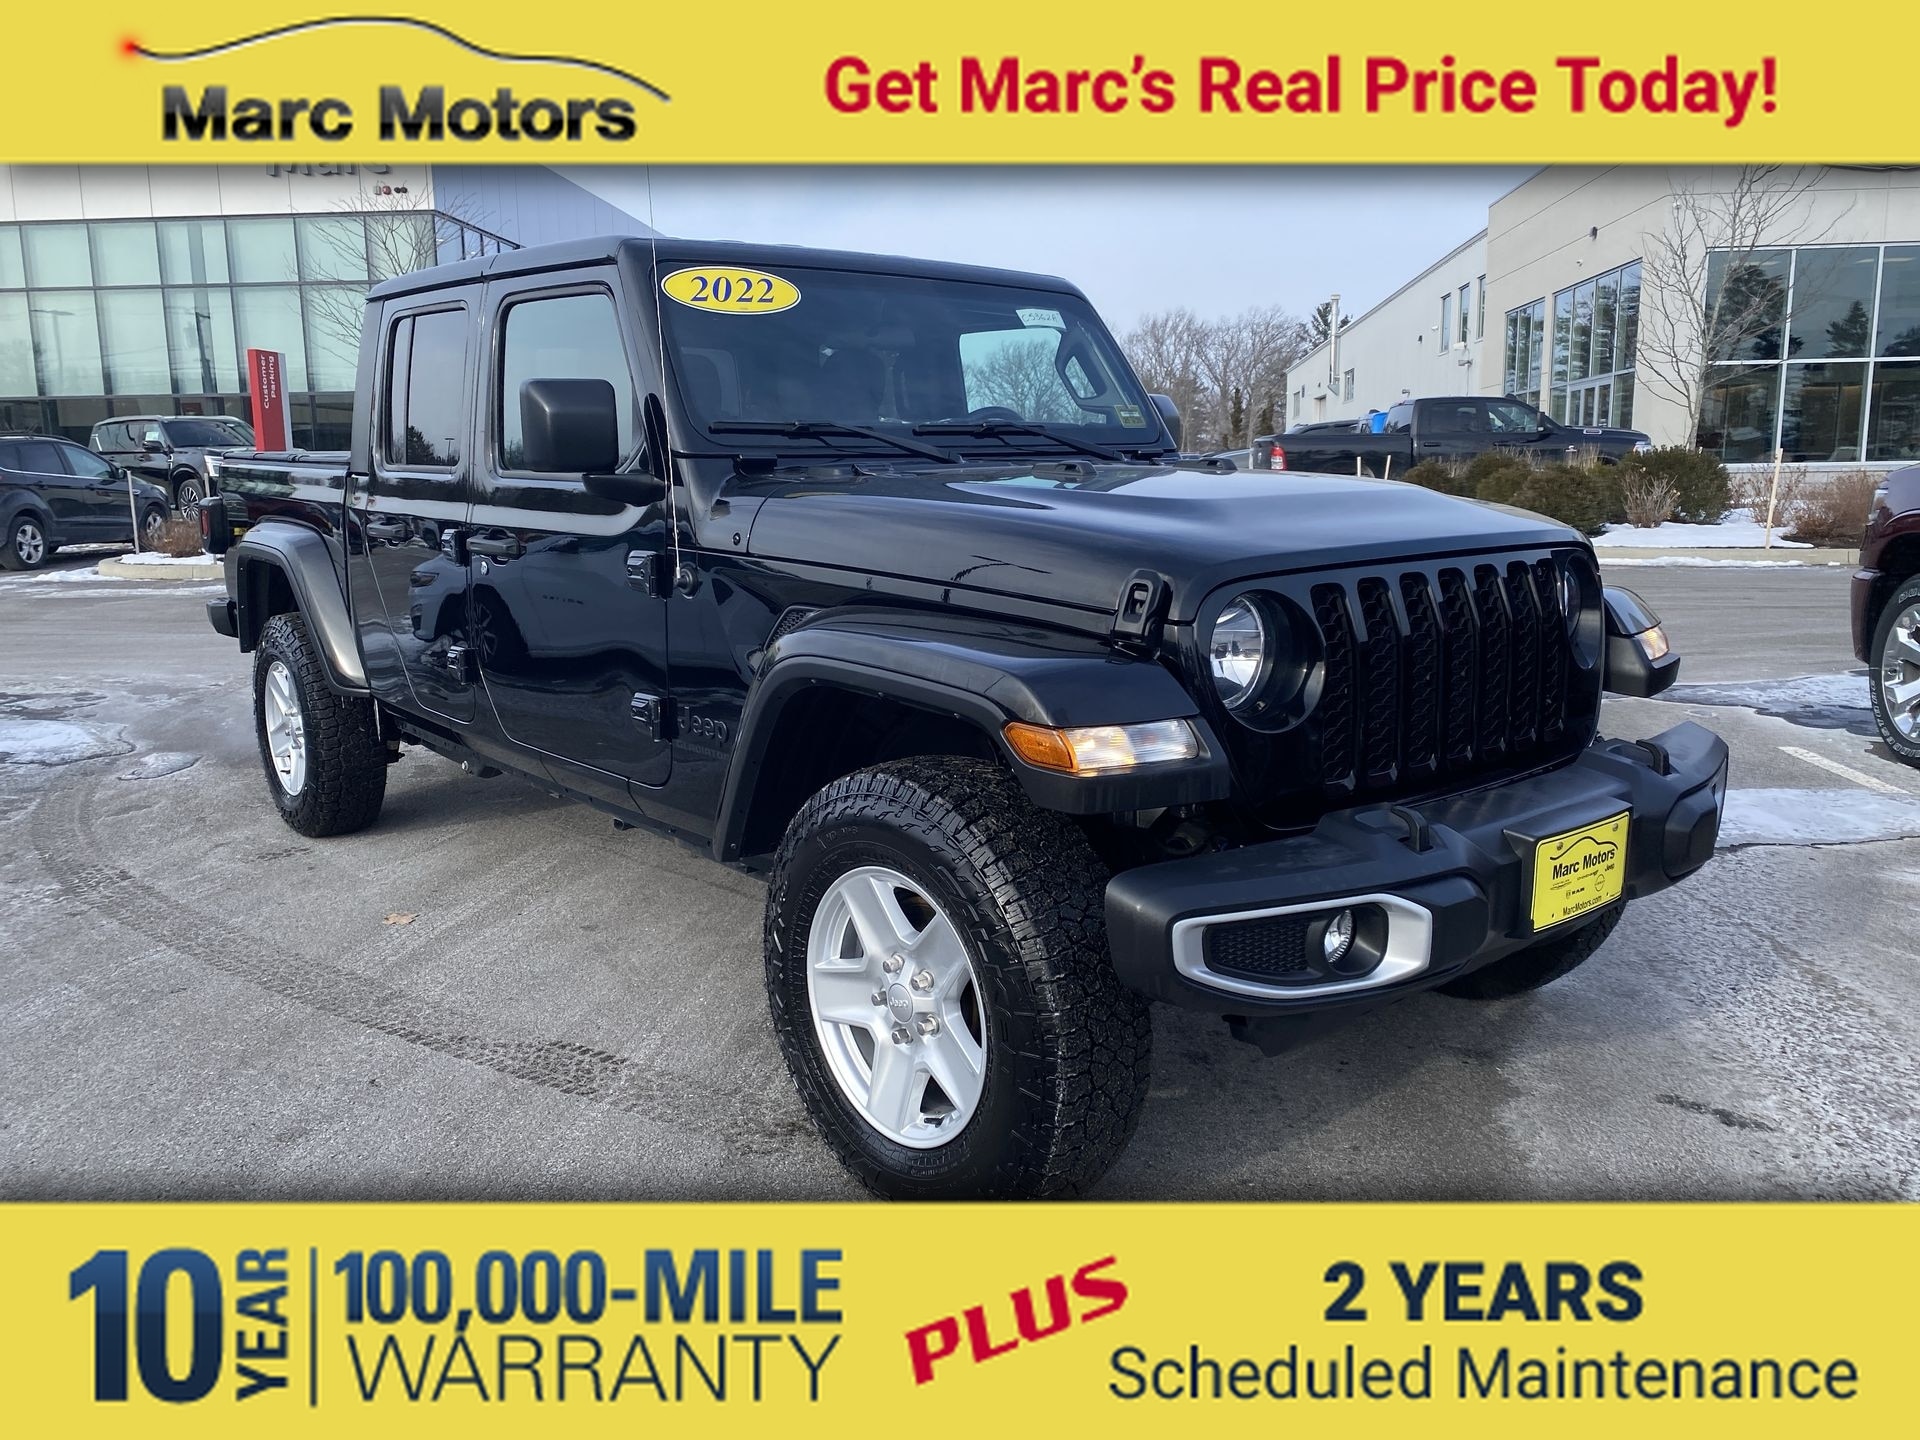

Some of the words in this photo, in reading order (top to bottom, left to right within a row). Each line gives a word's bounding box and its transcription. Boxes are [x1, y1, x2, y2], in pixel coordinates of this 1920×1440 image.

[690, 276, 775, 303] 2022
[261, 354, 270, 409] Customer
[678, 706, 728, 747] Jeep
[1552, 862, 1580, 880] Marc
[1582, 848, 1616, 870] Motors
[1562, 895, 1602, 916] MarcMotors.com
